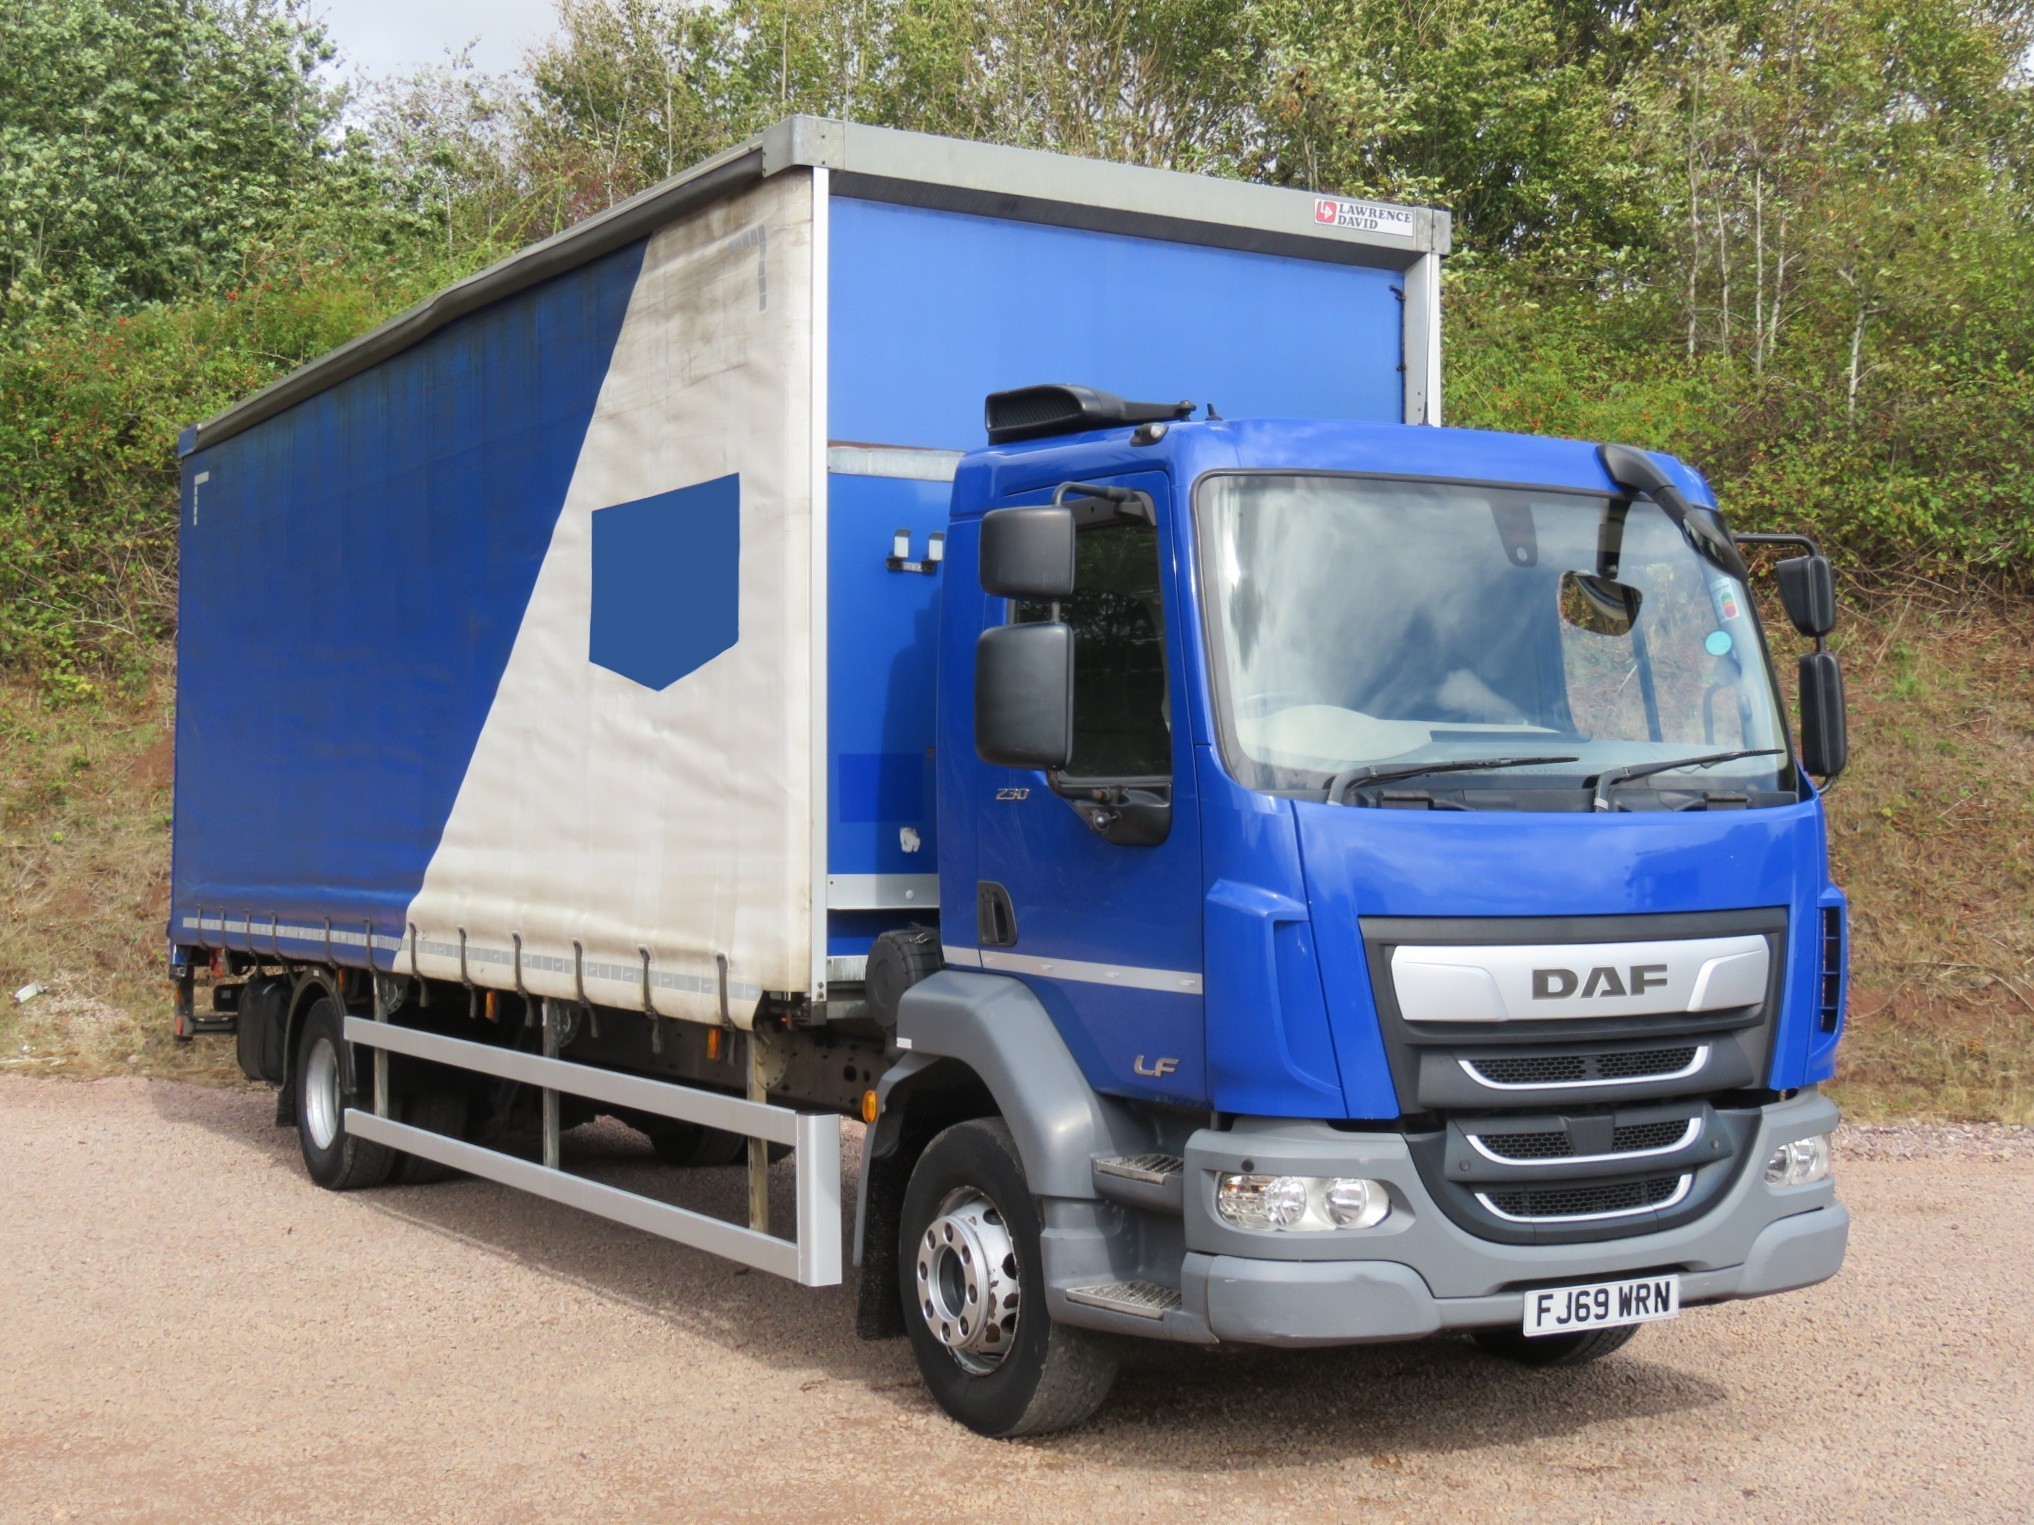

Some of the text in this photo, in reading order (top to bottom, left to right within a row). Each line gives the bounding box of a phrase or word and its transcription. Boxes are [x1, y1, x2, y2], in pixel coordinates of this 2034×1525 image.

[1338, 215, 1379, 230] DAVID
[1339, 203, 1412, 223] LAWRENCE
[996, 788, 1029, 800] 230
[1532, 964, 1668, 1000] DAF
[1134, 1054, 1179, 1077] LF
[1536, 1281, 1671, 1328] FJ69 WRN
